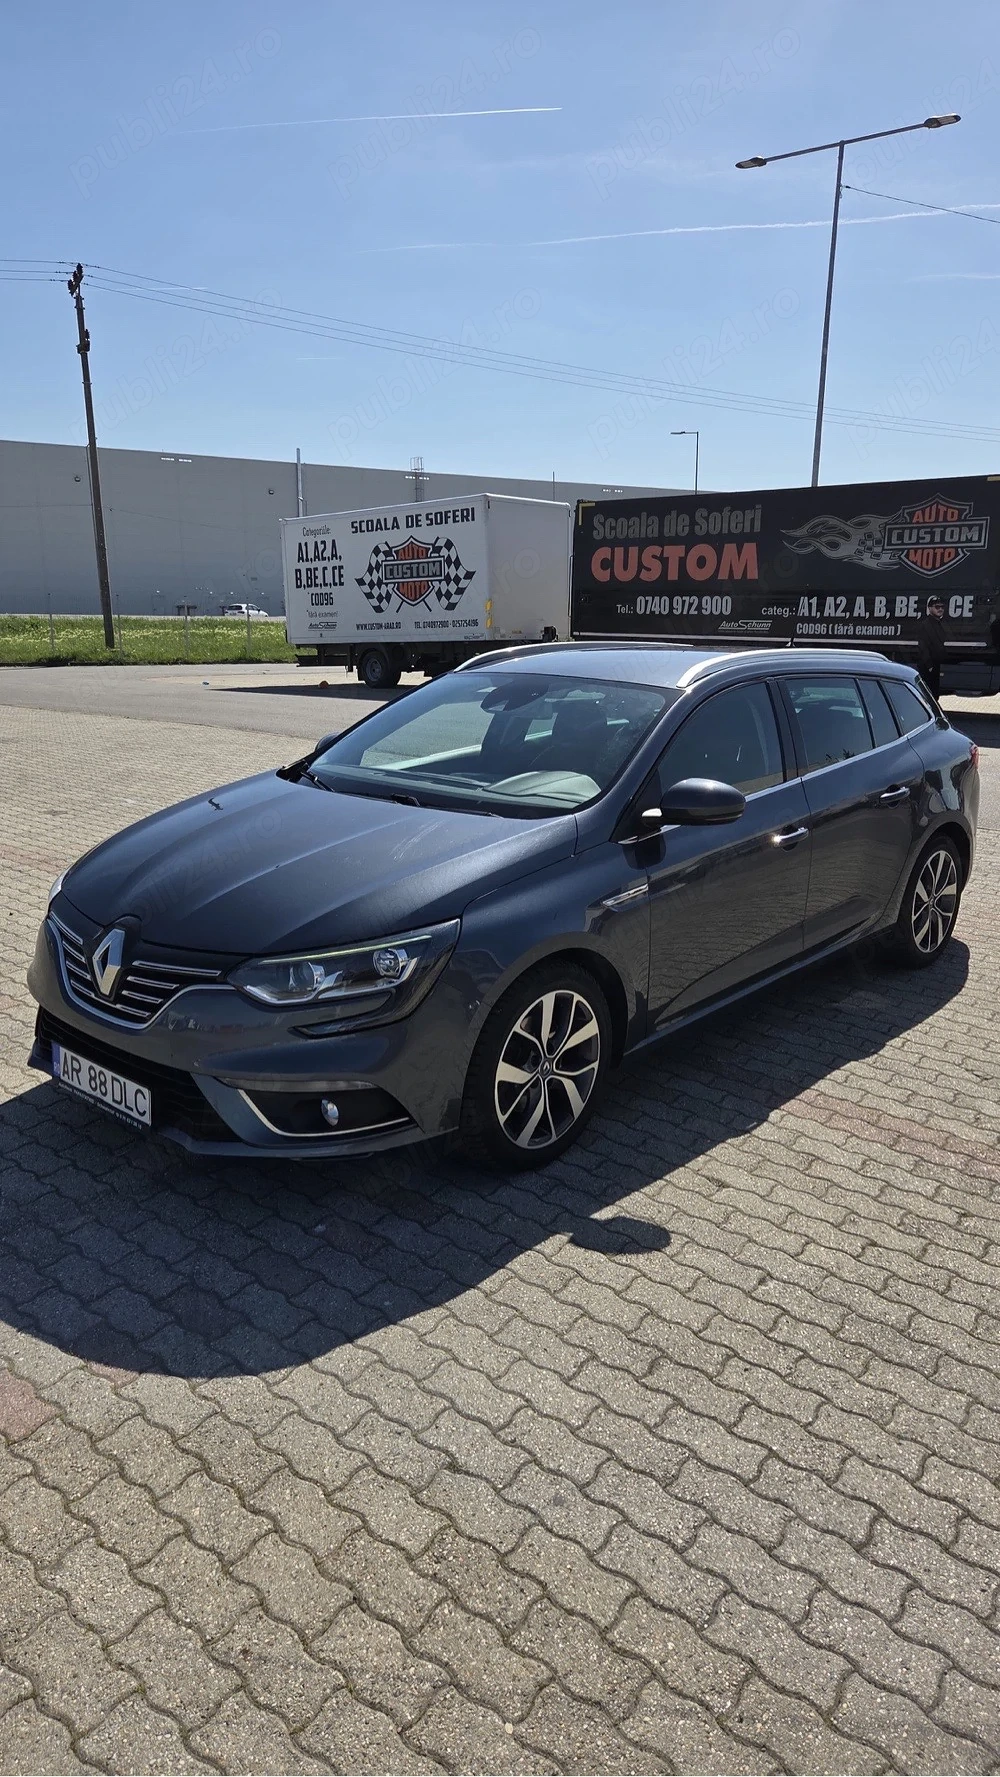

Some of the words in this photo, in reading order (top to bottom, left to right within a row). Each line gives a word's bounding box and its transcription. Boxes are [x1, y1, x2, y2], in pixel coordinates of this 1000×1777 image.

[351, 516, 400, 534] SCOALA
[405, 514, 422, 529] DE
[425, 507, 475, 526] SOFERI
[592, 511, 660, 540] Scoala
[663, 510, 690, 537] de
[694, 504, 762, 536] Soferi
[912, 503, 959, 523] AUTO
[891, 525, 979, 544] CUSTOM
[398, 544, 426, 559] AUTO
[908, 548, 956, 569] MOTO
[385, 562, 440, 579] CUSTOM
[590, 542, 759, 582] CUSTOM
[399, 581, 427, 600] MOTO
[616, 604, 634, 614] Tel.:
[636, 595, 670, 615] 0740
[672, 595, 699, 615] 972
[701, 595, 732, 615] 900
[761, 605, 796, 618] categ.:
[823, 596, 850, 619] A2,
[852, 596, 870, 619] A,
[874, 596, 891, 619] B,
[894, 595, 922, 619] BE,
[948, 595, 974, 618] CE
[718, 619, 773, 630] AutoSchunn
[796, 623, 827, 635] COD96
[834, 622, 854, 635] fără
[855, 624, 895, 636] examen
[62, 1052, 82, 1086] AR
[88, 1065, 107, 1097] 88
[111, 1075, 147, 1117] DLC
